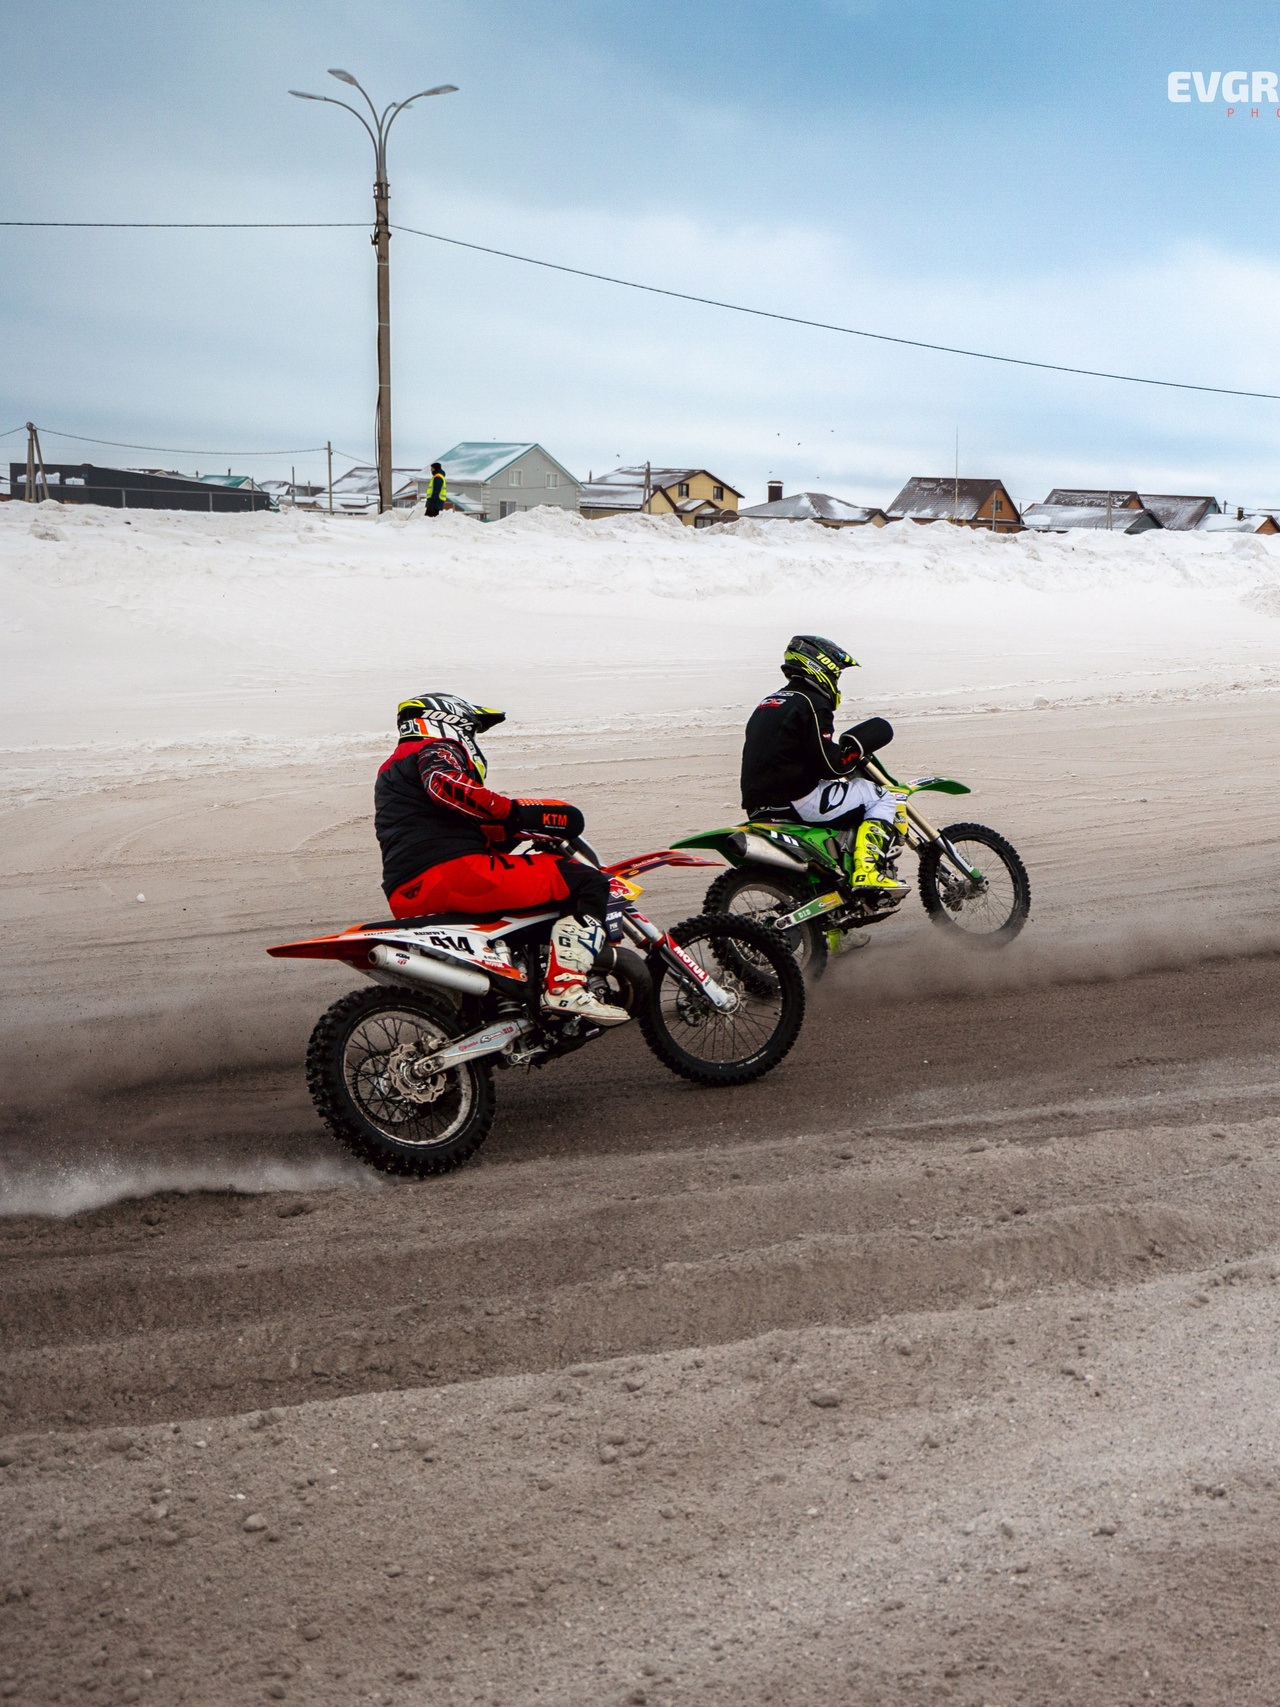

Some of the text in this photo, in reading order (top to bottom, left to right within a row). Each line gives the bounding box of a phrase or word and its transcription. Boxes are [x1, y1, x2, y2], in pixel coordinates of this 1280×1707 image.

[816, 652, 840, 677] 100%
[421, 709, 474, 731] 100%
[542, 813, 568, 827] KTM
[429, 935, 475, 956] 414
[673, 946, 706, 980] MOTUL
